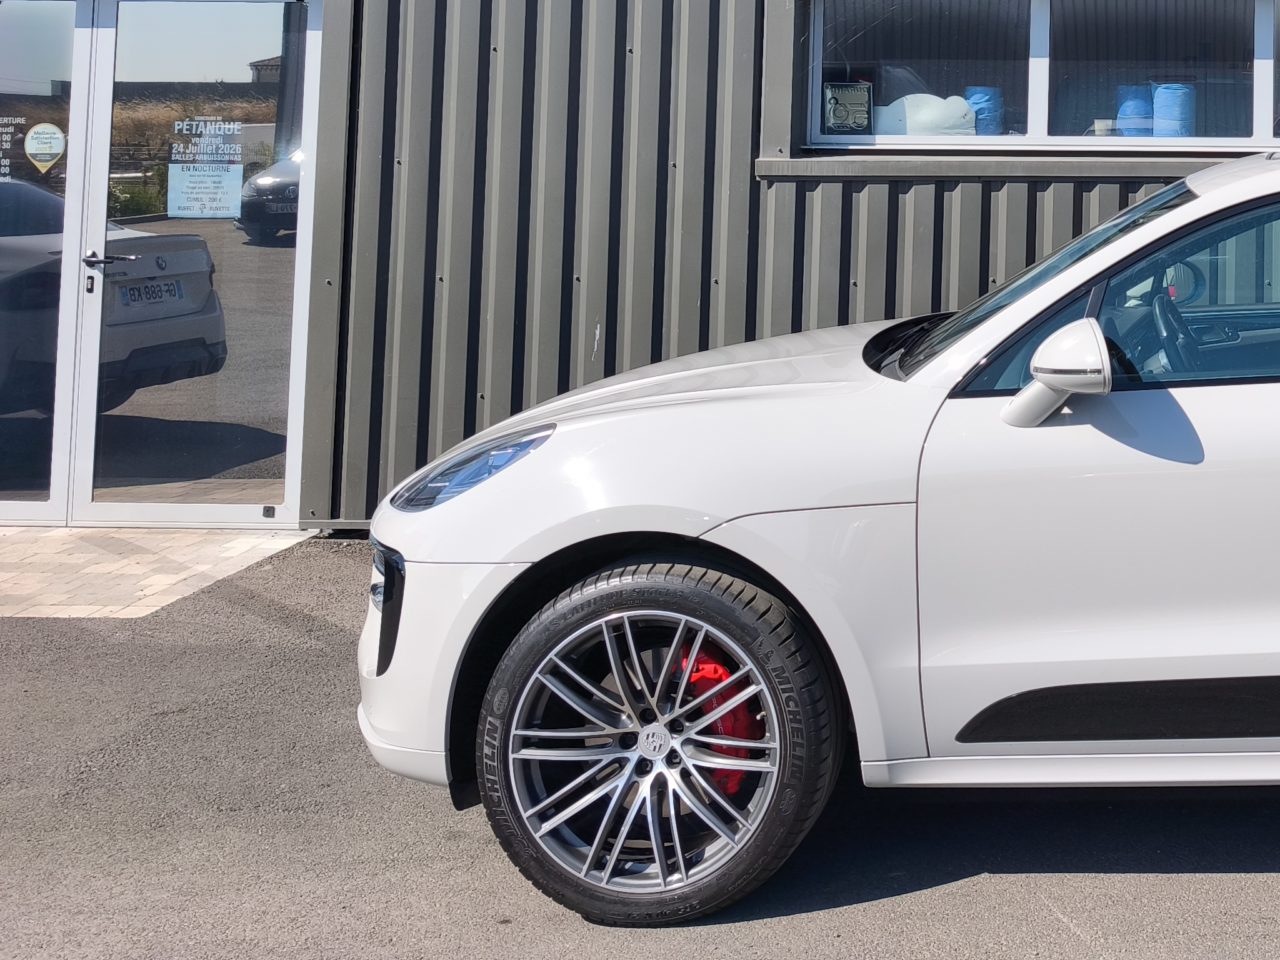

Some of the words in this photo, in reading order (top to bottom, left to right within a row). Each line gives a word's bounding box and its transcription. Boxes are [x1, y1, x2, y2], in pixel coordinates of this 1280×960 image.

[174, 118, 242, 135] PÉTANQUE
[172, 143, 184, 153] 24
[185, 143, 216, 153] Juillet
[769, 665, 806, 782] MICHELIN
